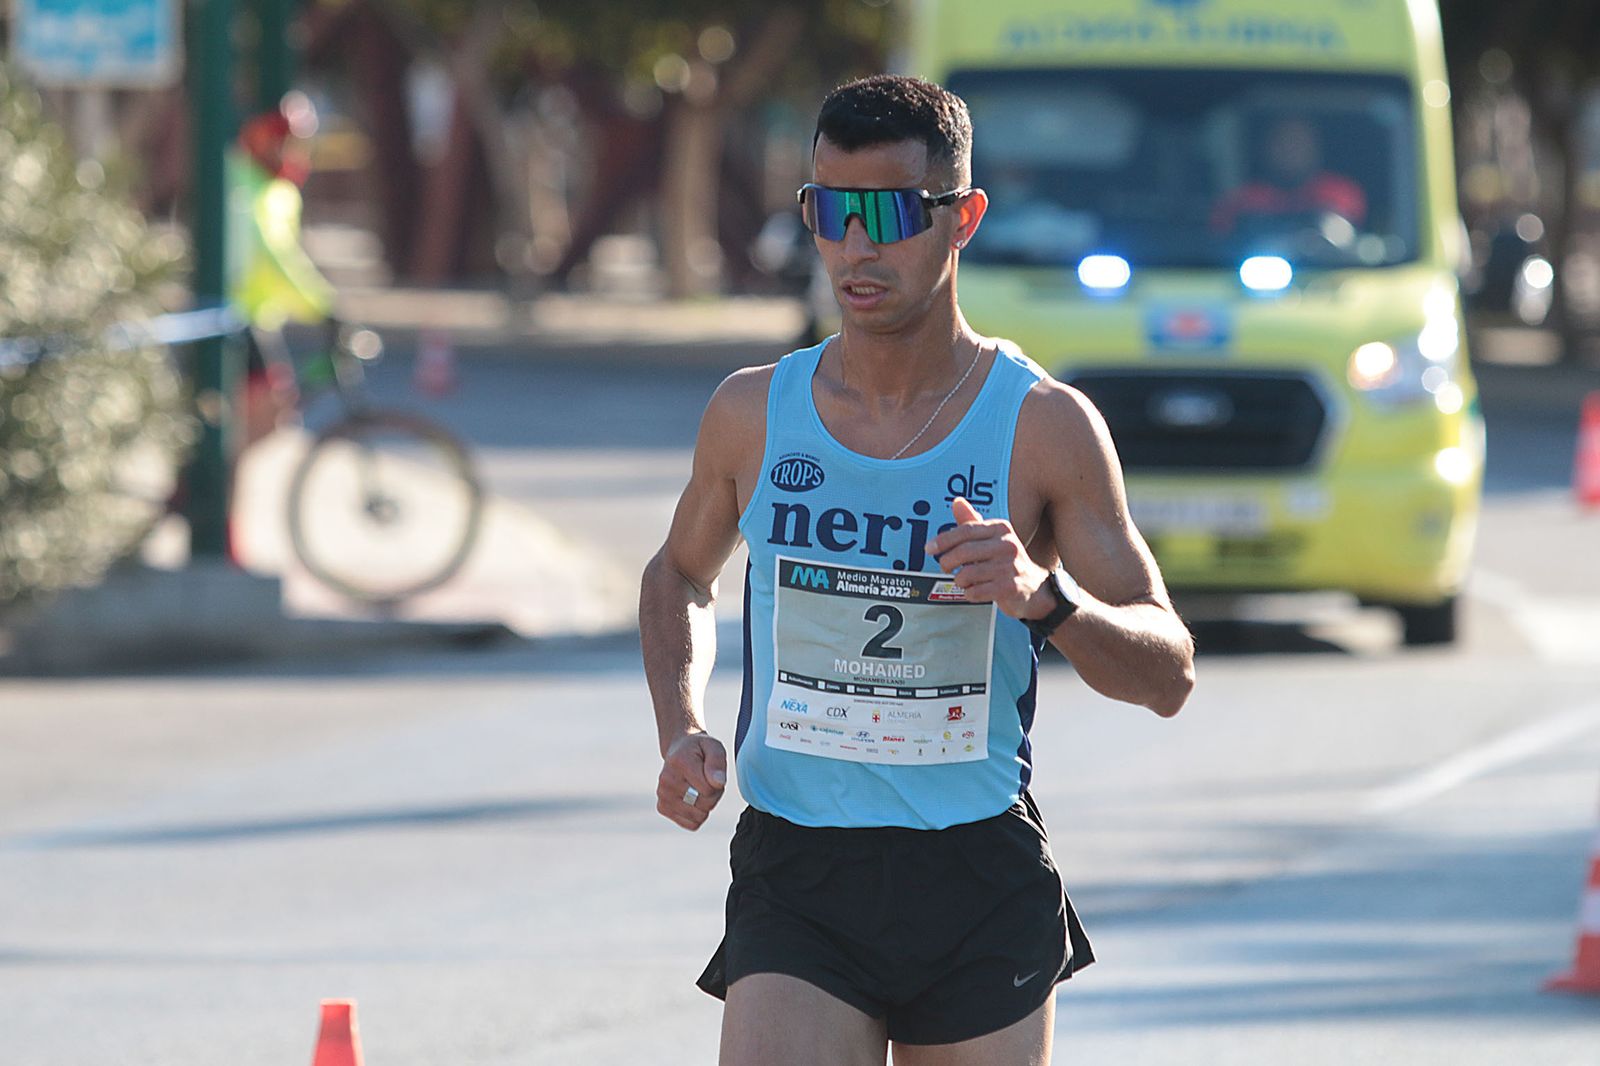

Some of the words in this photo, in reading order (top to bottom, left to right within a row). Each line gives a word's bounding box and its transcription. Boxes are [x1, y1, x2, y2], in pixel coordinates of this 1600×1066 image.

[773, 460, 822, 487] TROPS
[767, 500, 958, 572] nerj
[837, 571, 868, 583] Medio
[870, 574, 912, 587] Maratón
[836, 581, 879, 596] Almería
[880, 586, 911, 598] 2022
[862, 603, 904, 660] 2
[834, 659, 926, 679] MOHAMED
[853, 676, 885, 684] MOHAMED
[780, 700, 808, 714] NEXA
[826, 706, 850, 718] CDX
